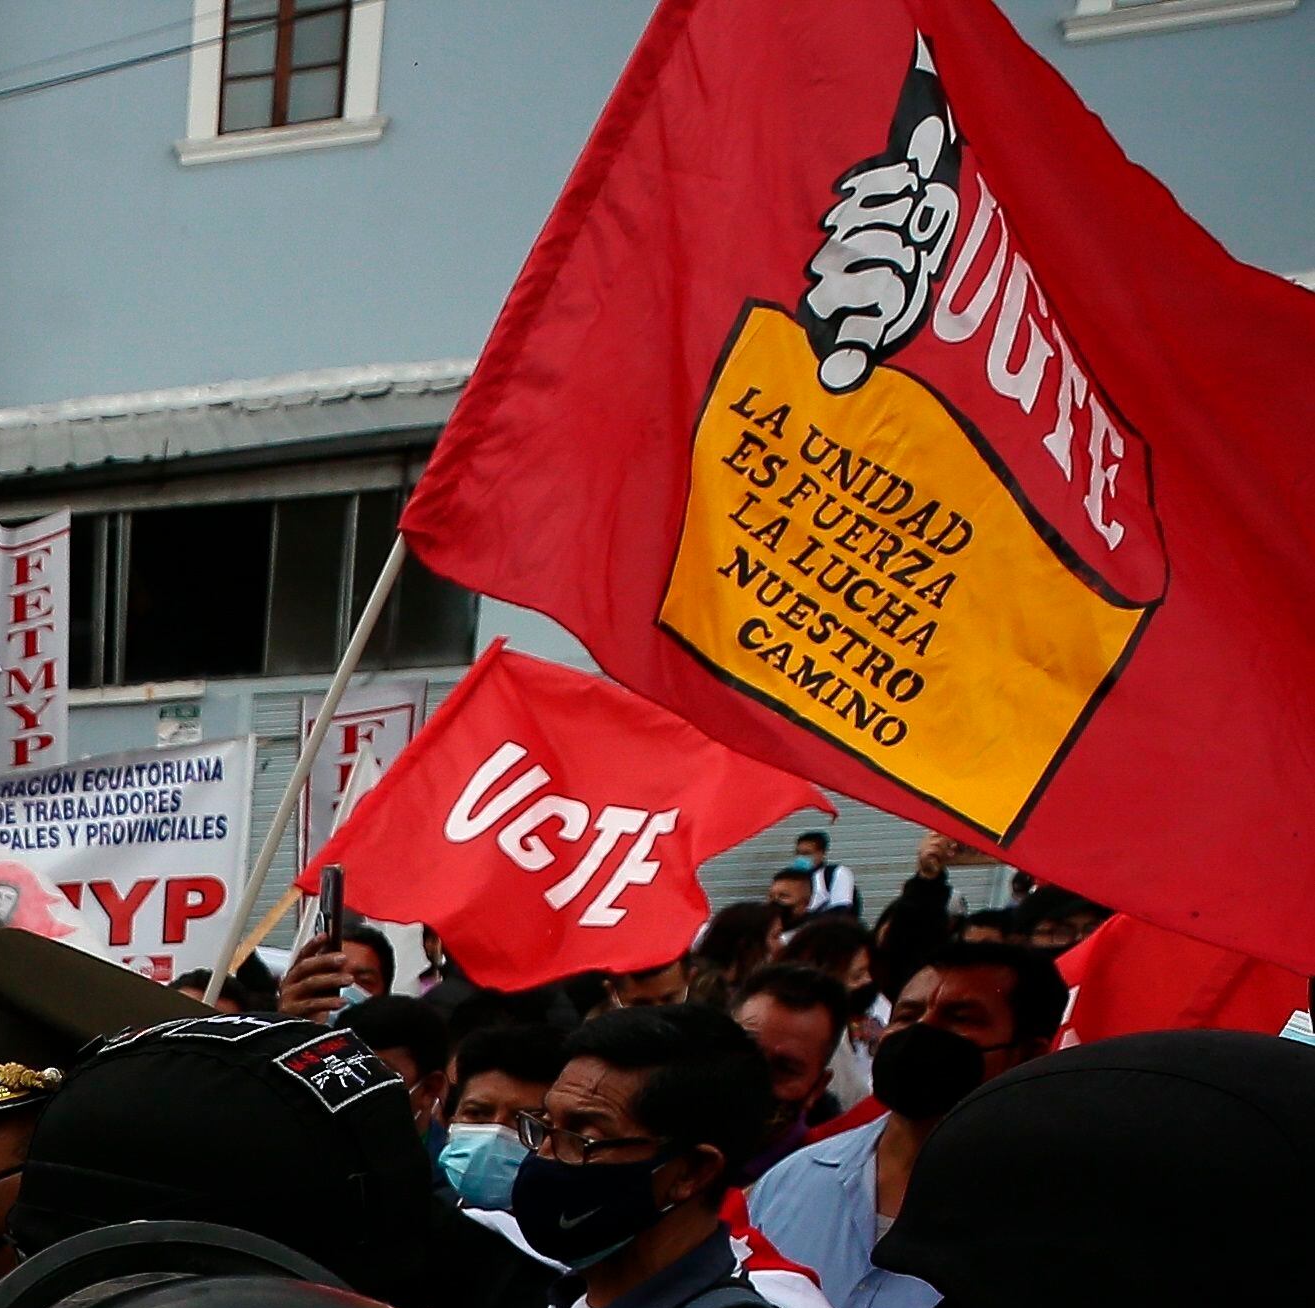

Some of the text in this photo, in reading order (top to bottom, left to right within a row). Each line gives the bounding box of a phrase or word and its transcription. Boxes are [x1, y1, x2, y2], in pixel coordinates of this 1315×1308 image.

[932, 172, 1124, 551] UGTE
[721, 431, 958, 609] ES FUERZA
[729, 387, 974, 555] LA UNIDAD
[6, 545, 58, 767] FETMYP
[717, 545, 926, 703] NUESTRO
[728, 491, 939, 656] LA LUCHA
[736, 617, 909, 747] CAMINO
[23, 788, 183, 823] TRABAJADORES
[67, 824, 80, 846] Y
[86, 815, 228, 847] PROVINCIALES
[82, 756, 224, 791] ECUATORIANA
[443, 740, 681, 927] UGTE
